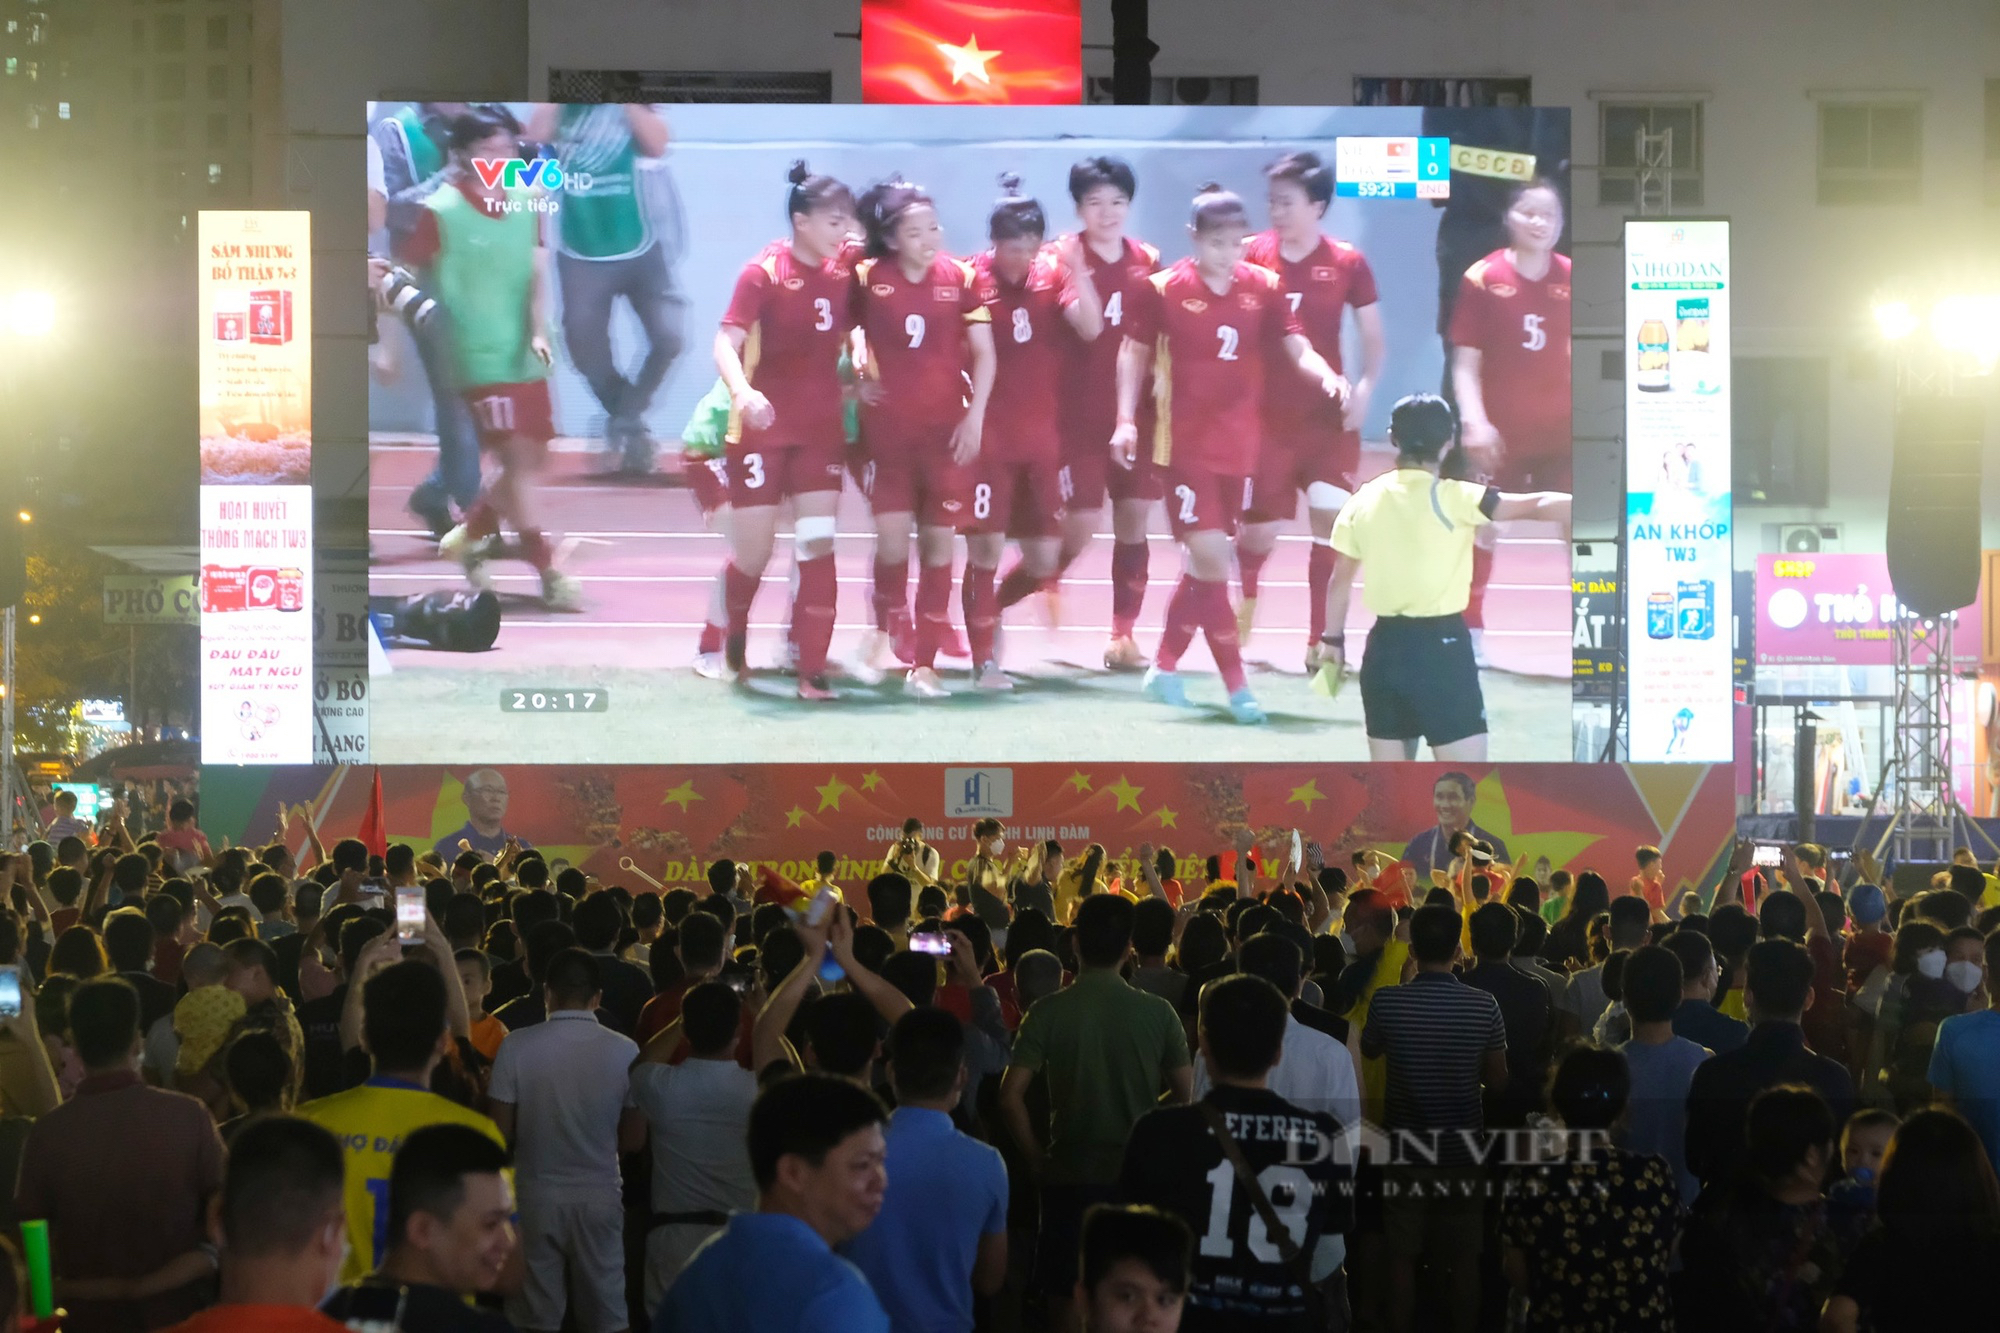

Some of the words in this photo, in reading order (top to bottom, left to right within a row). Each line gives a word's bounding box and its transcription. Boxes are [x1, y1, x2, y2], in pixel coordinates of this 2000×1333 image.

[1429, 143, 1436, 157] 1
[564, 172, 593, 190] HD
[1427, 162, 1439, 176] 0
[1358, 182, 1395, 196] 59:21
[483, 197, 522, 215] Trực
[527, 195, 560, 215] tiếp
[245, 244, 293, 259] NHUNG
[814, 297, 833, 331] 3
[1104, 290, 1123, 326] 4
[1285, 292, 1303, 313] 7
[905, 313, 926, 348] 9
[1012, 306, 1033, 343] 8
[1522, 313, 1546, 351] 5
[1217, 325, 1239, 361] 2
[743, 453, 765, 488] 3
[974, 483, 992, 519] 8
[1175, 483, 1199, 524] 2
[282, 529, 307, 548] TW3
[1633, 525, 1661, 540] AN
[1670, 518, 1728, 540] KHỚP
[1666, 547, 1697, 561] TW3
[1773, 559, 1815, 577] SHOP
[107, 579, 164, 614] PHỞ
[1814, 583, 1873, 623] THỎ
[336, 673, 365, 701] BÒ
[345, 706, 364, 717] CAO
[512, 692, 597, 709] 20:17
[947, 825, 968, 840] CƯ
[1025, 826, 1056, 840] LINH
[1059, 823, 1090, 840] ĐÀM
[1206, 1111, 1318, 1146] EFEREE
[1200, 1158, 1314, 1264] 18
